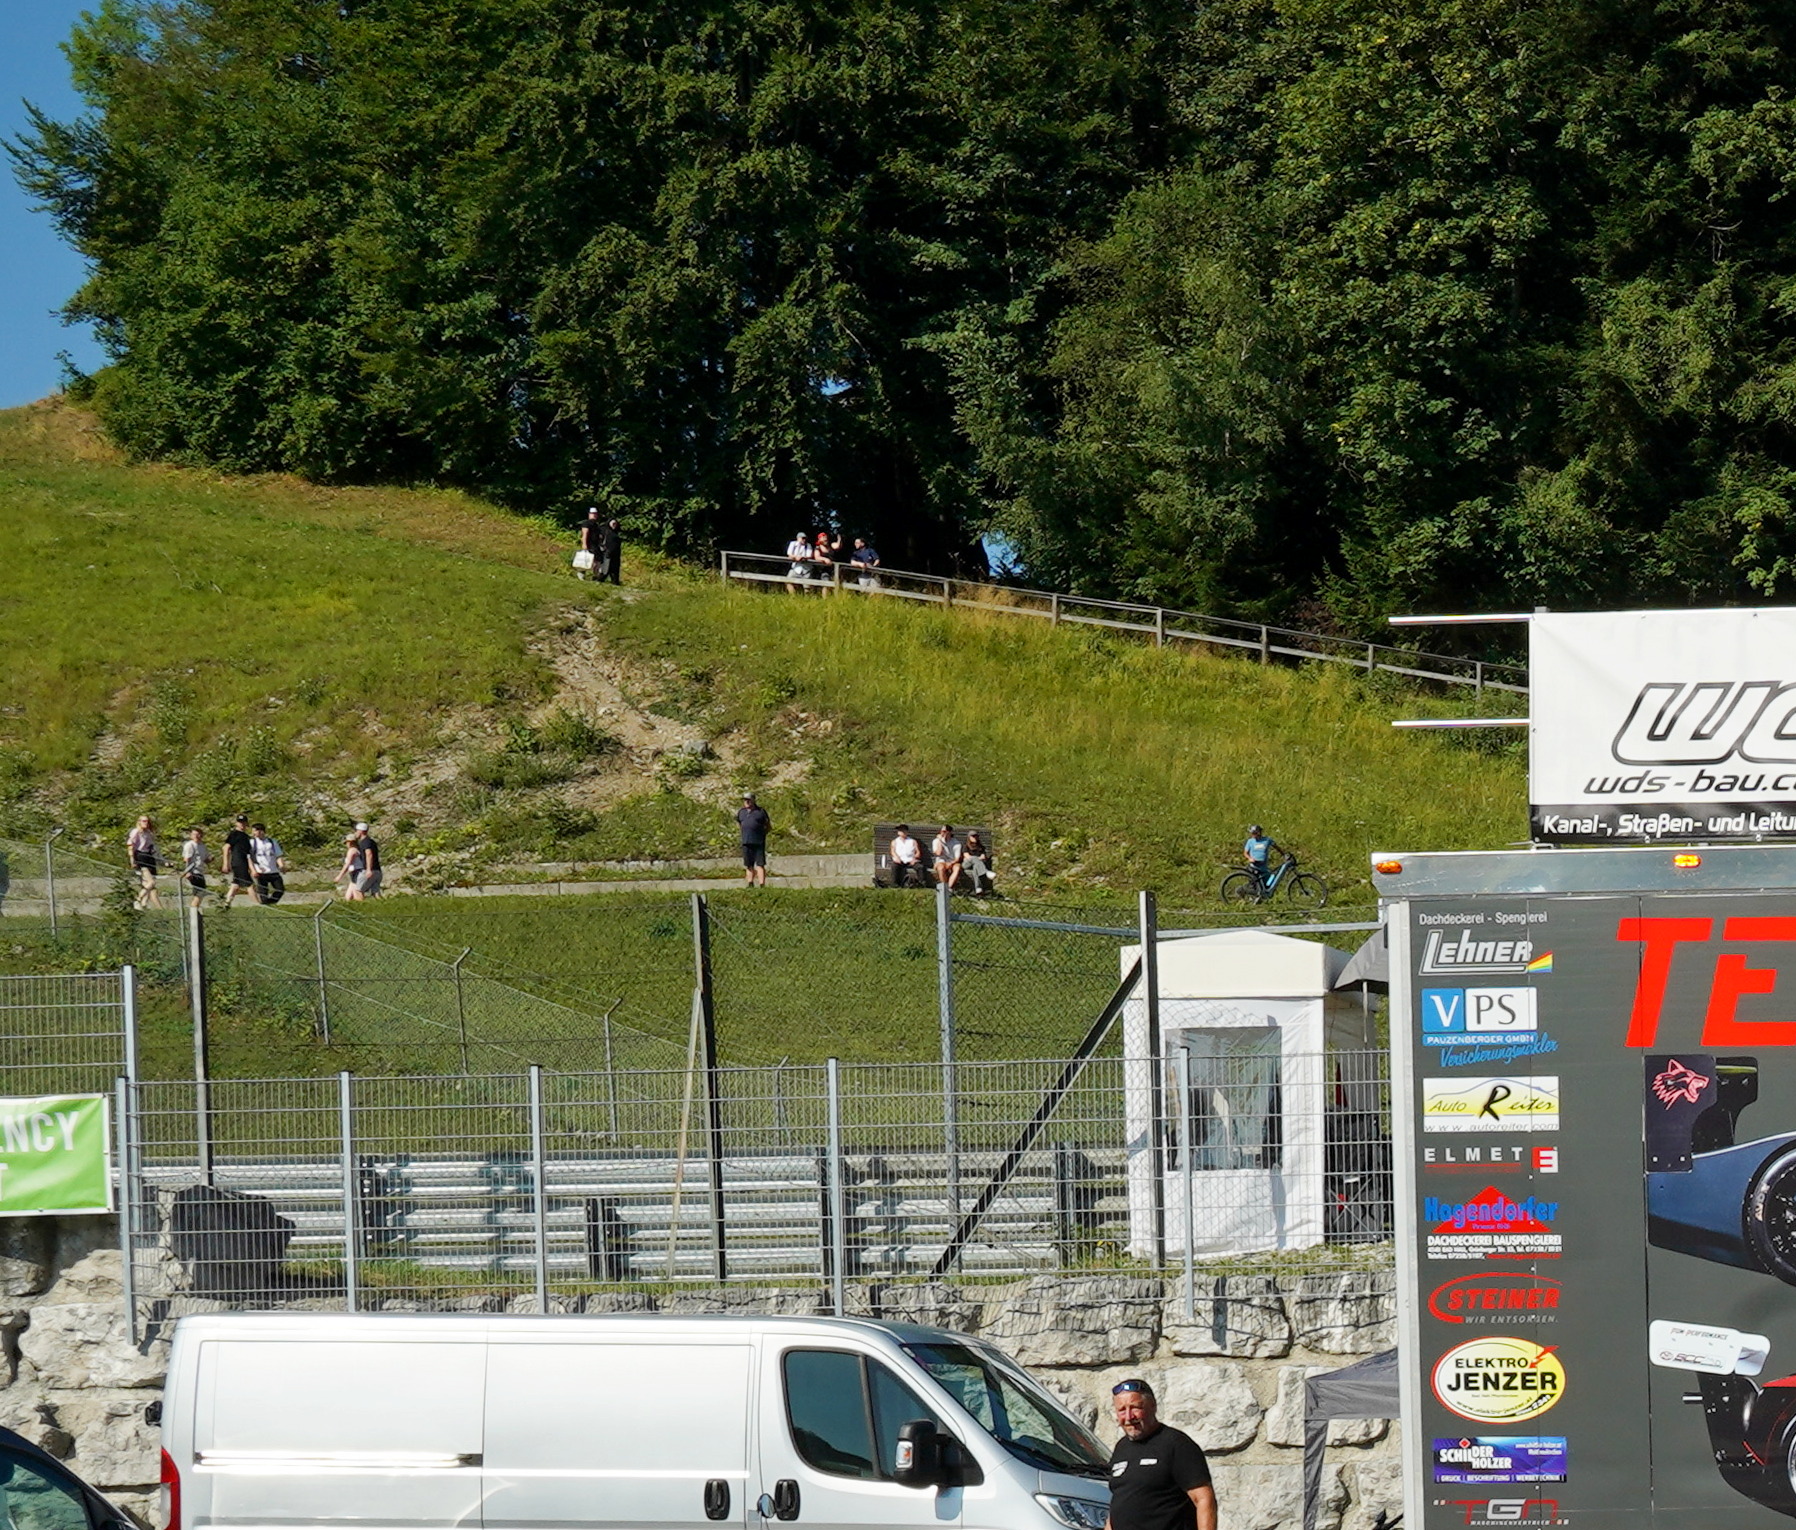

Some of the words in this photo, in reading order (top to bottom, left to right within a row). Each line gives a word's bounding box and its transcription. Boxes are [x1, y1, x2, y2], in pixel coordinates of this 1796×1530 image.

[1542, 813, 1614, 837] Kanal-,
[1705, 812, 1745, 833] und
[1419, 913, 1484, 925] Dachdeckerei
[1495, 911, 1548, 925] Spenglerei
[1427, 1035, 1503, 1044] PAUZENBERGER
[1429, 1099, 1467, 1112] Auto
[1424, 1147, 1523, 1162] ELMET
[1427, 1235, 1493, 1246] DACHDECKEREI
[1493, 1234, 1562, 1246] BAUSPENGLEREI
[1447, 1288, 1561, 1310] STEINER
[1465, 1316, 1486, 1324] WIR
[1455, 1358, 1529, 1369] ELEKTRO
[1446, 1372, 1558, 1391] JENZER
[1439, 1445, 1494, 1463] SCHILDER
